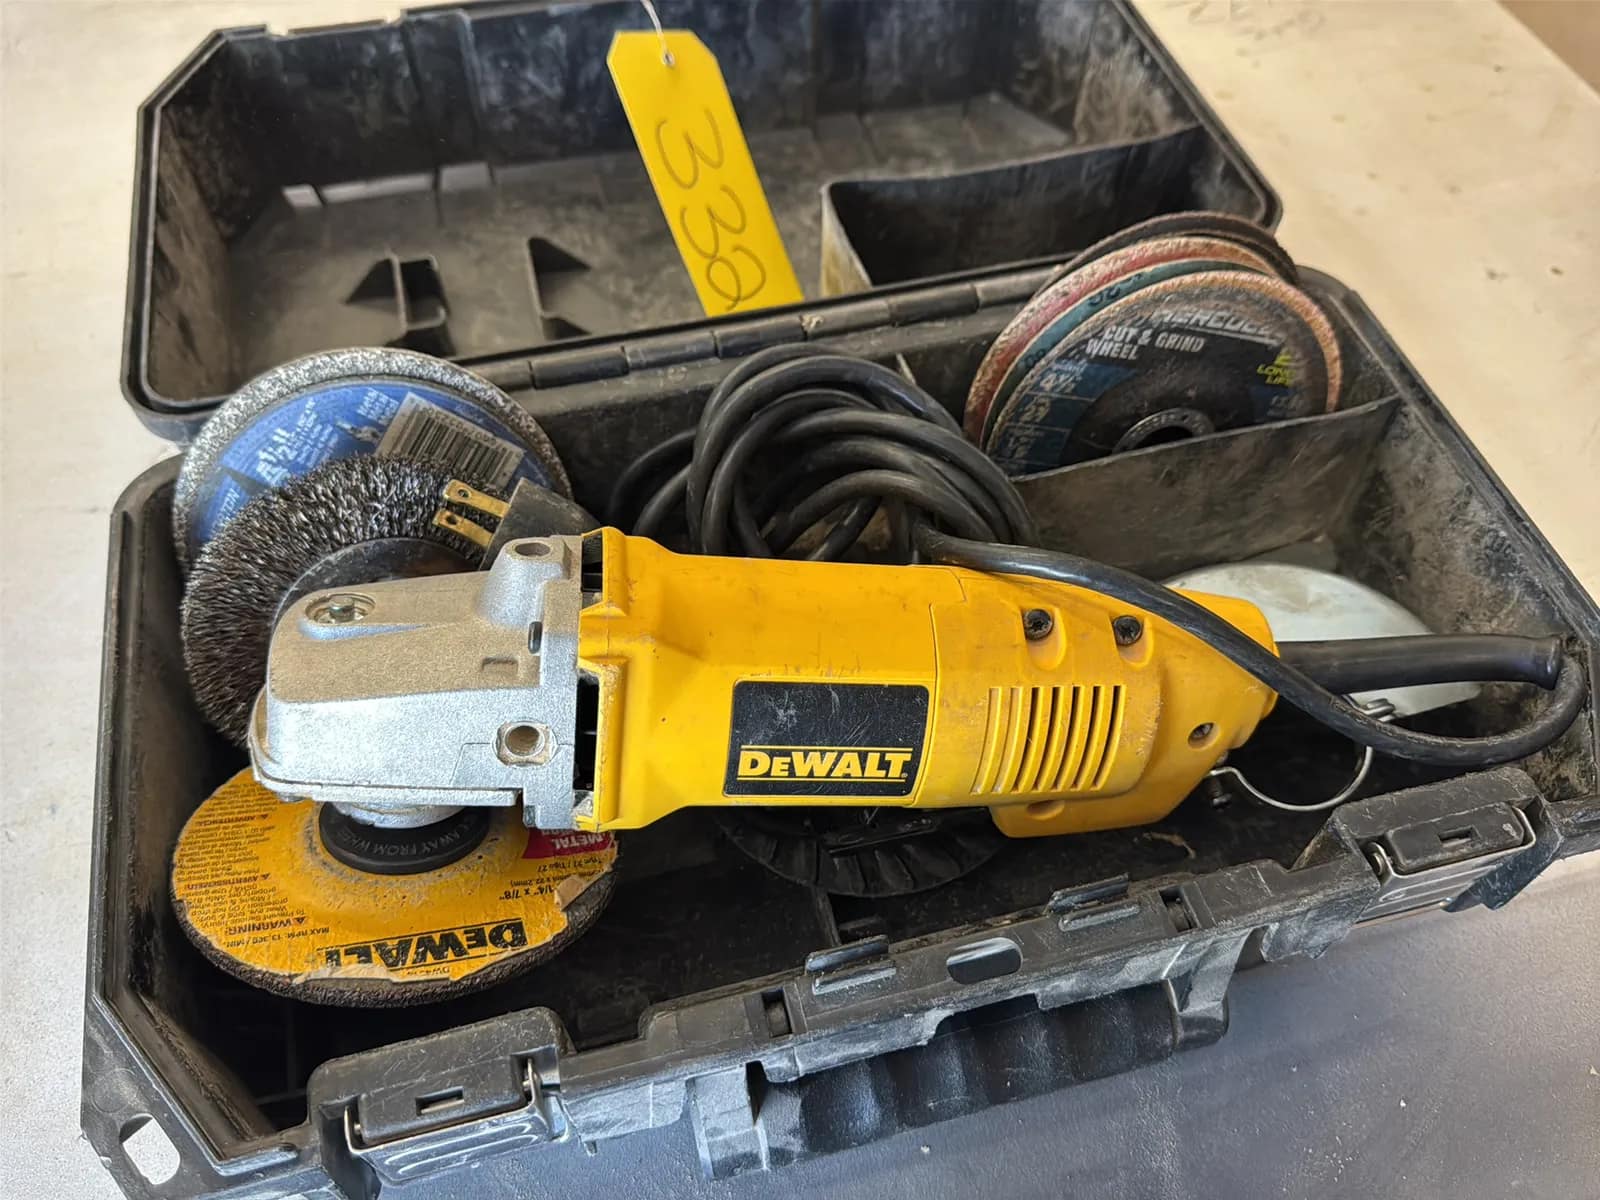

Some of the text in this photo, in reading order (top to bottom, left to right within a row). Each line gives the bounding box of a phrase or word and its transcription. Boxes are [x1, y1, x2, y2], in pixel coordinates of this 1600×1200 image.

[1085, 338, 1140, 361] WHEEL
[1103, 326, 1207, 353] CUT & GRIND
[333, 821, 460, 857] AWAY FROM WHEE
[551, 833, 605, 849] METAL
[310, 926, 330, 935] MAX
